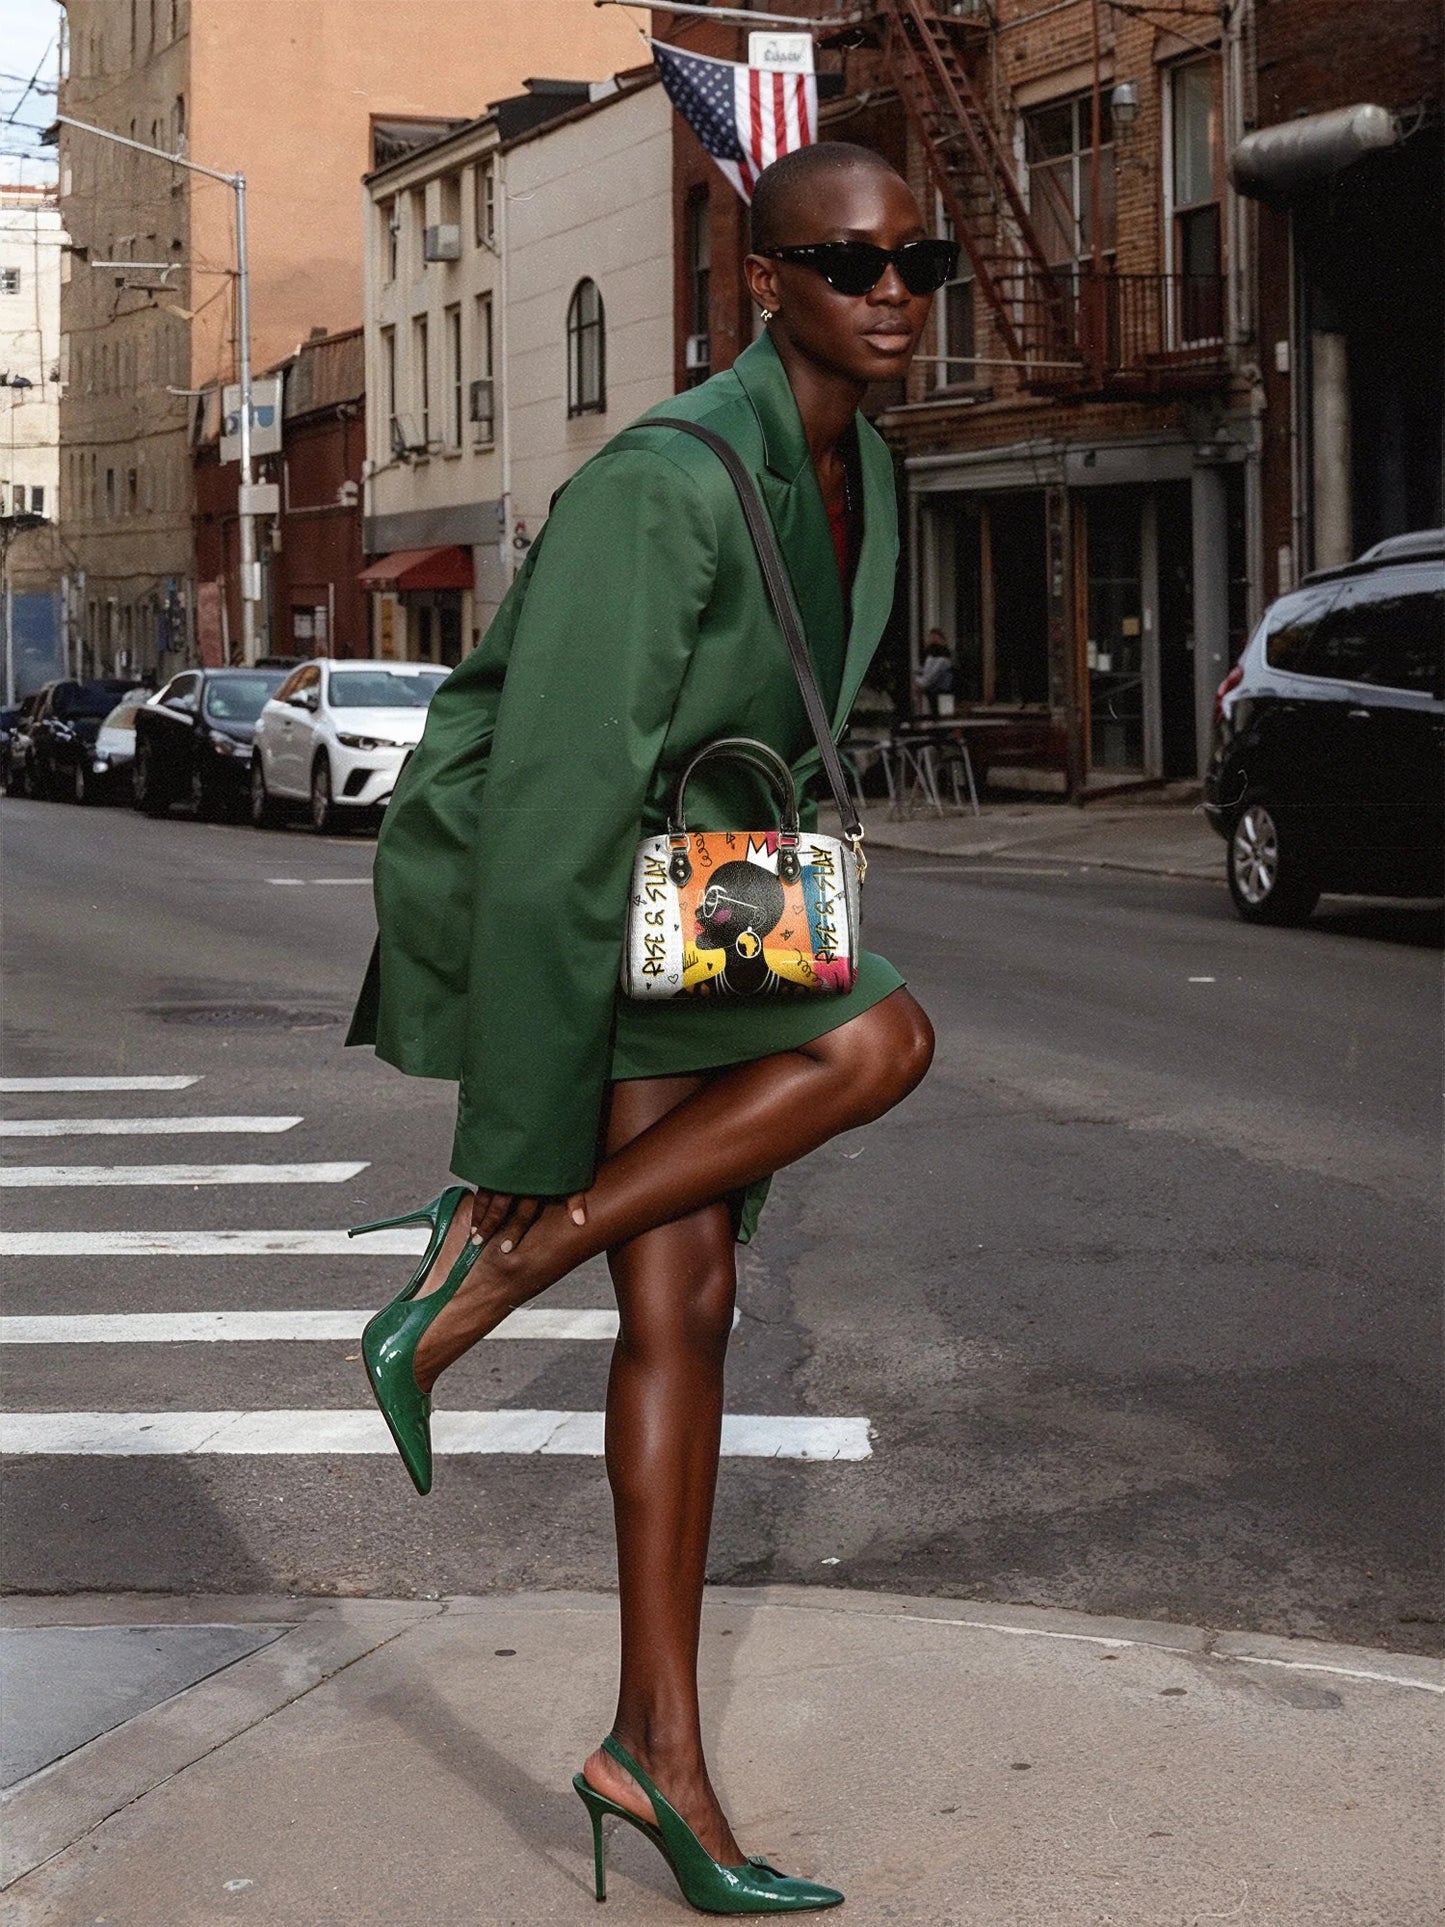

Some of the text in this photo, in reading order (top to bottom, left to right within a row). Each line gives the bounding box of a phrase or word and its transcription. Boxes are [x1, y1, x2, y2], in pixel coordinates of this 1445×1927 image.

[642, 855, 668, 977] RISE & SLAY
[810, 844, 838, 964] RISE & SLAY
